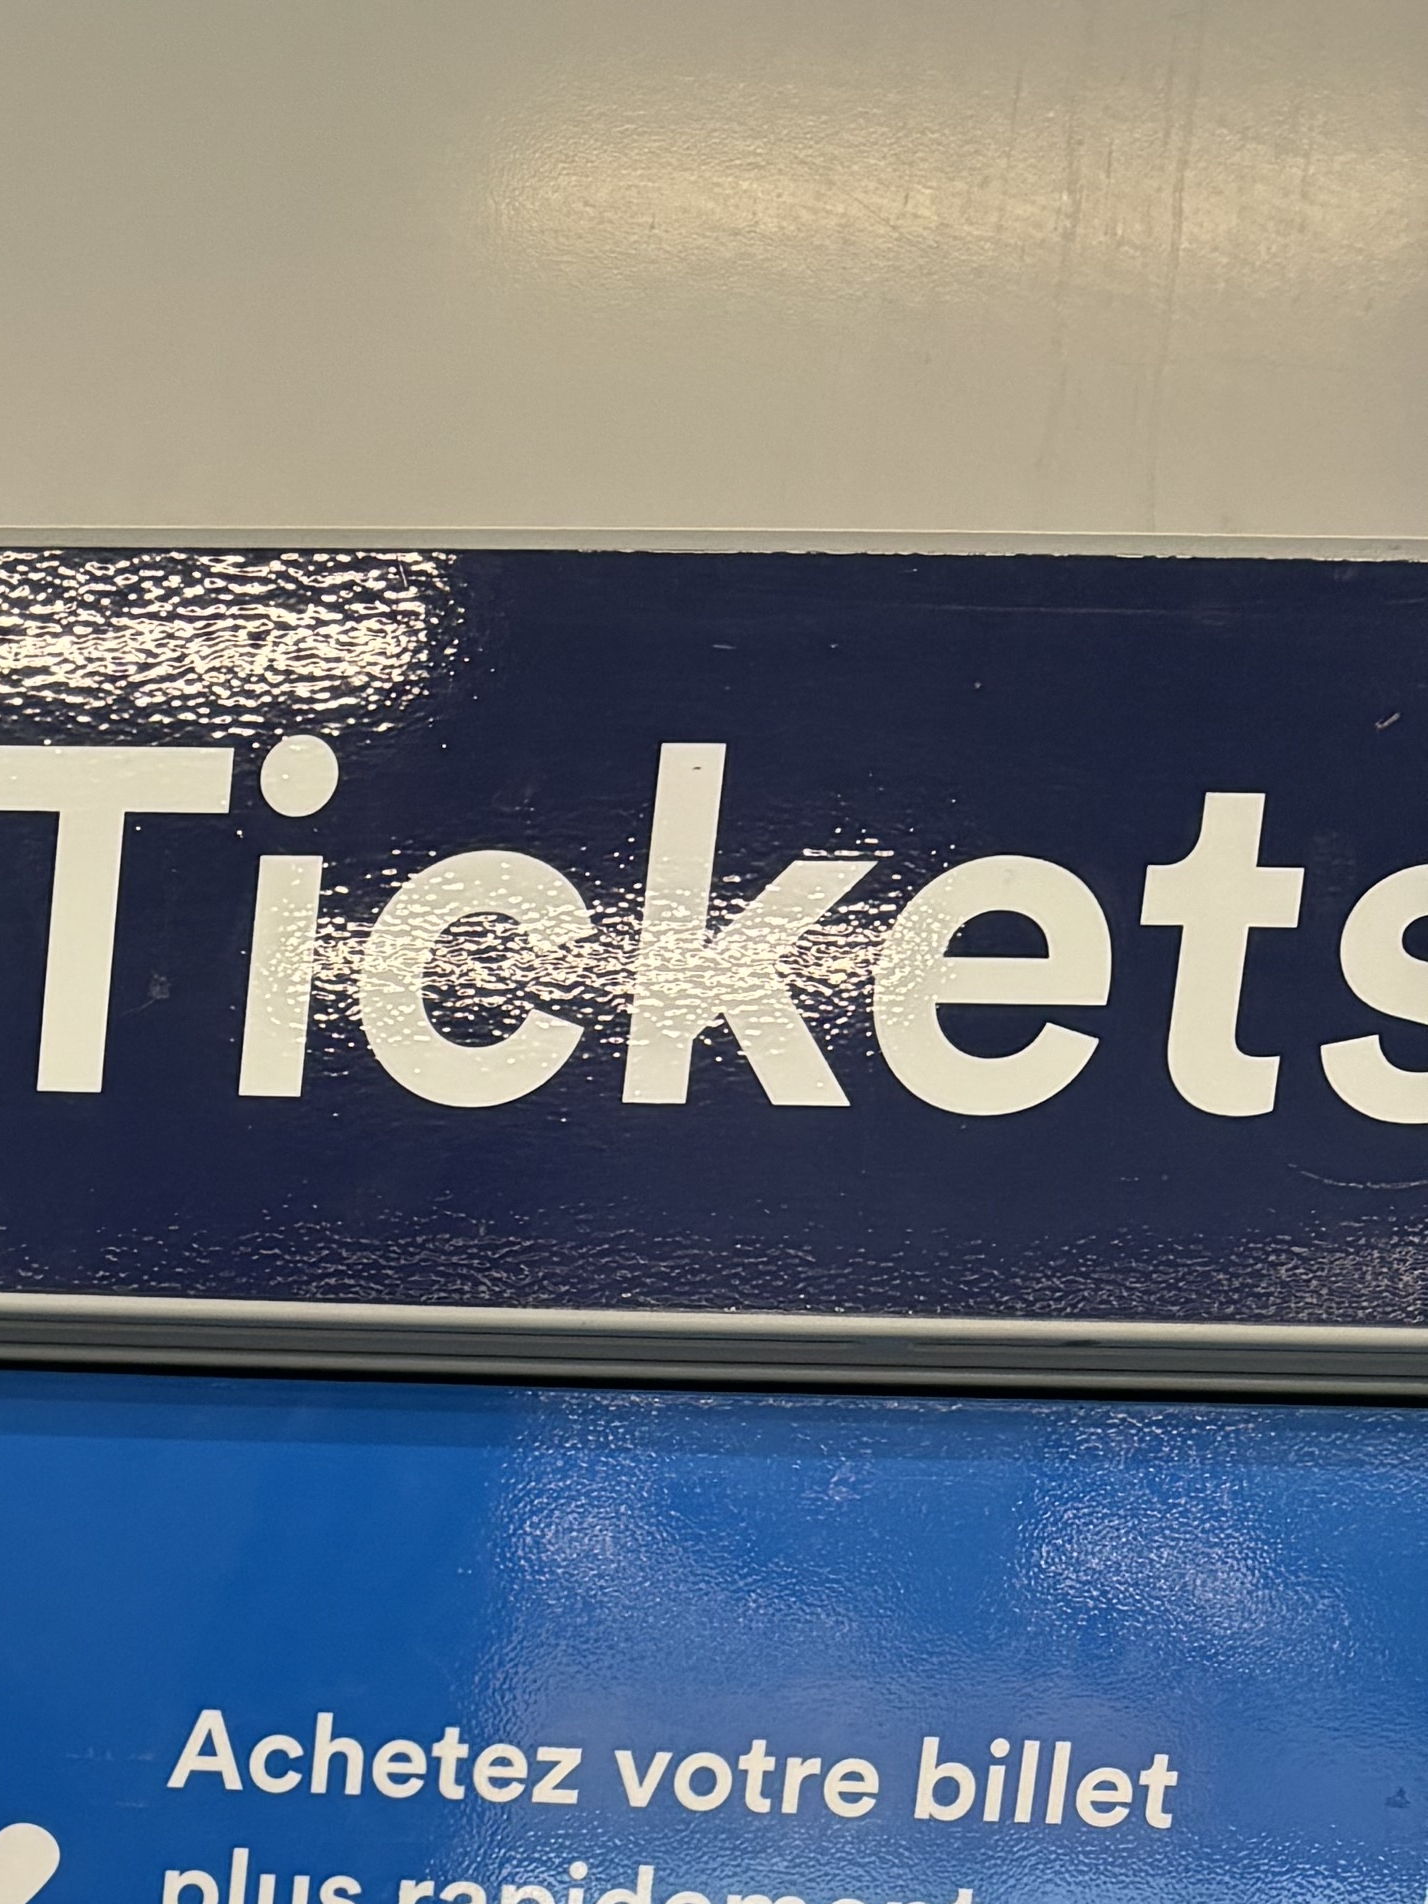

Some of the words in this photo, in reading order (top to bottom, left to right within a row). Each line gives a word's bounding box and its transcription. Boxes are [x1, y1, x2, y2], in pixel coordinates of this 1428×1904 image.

[166, 1709, 584, 1806] Achetez
[615, 1738, 881, 1819] votre
[913, 1736, 1180, 1830] billet
